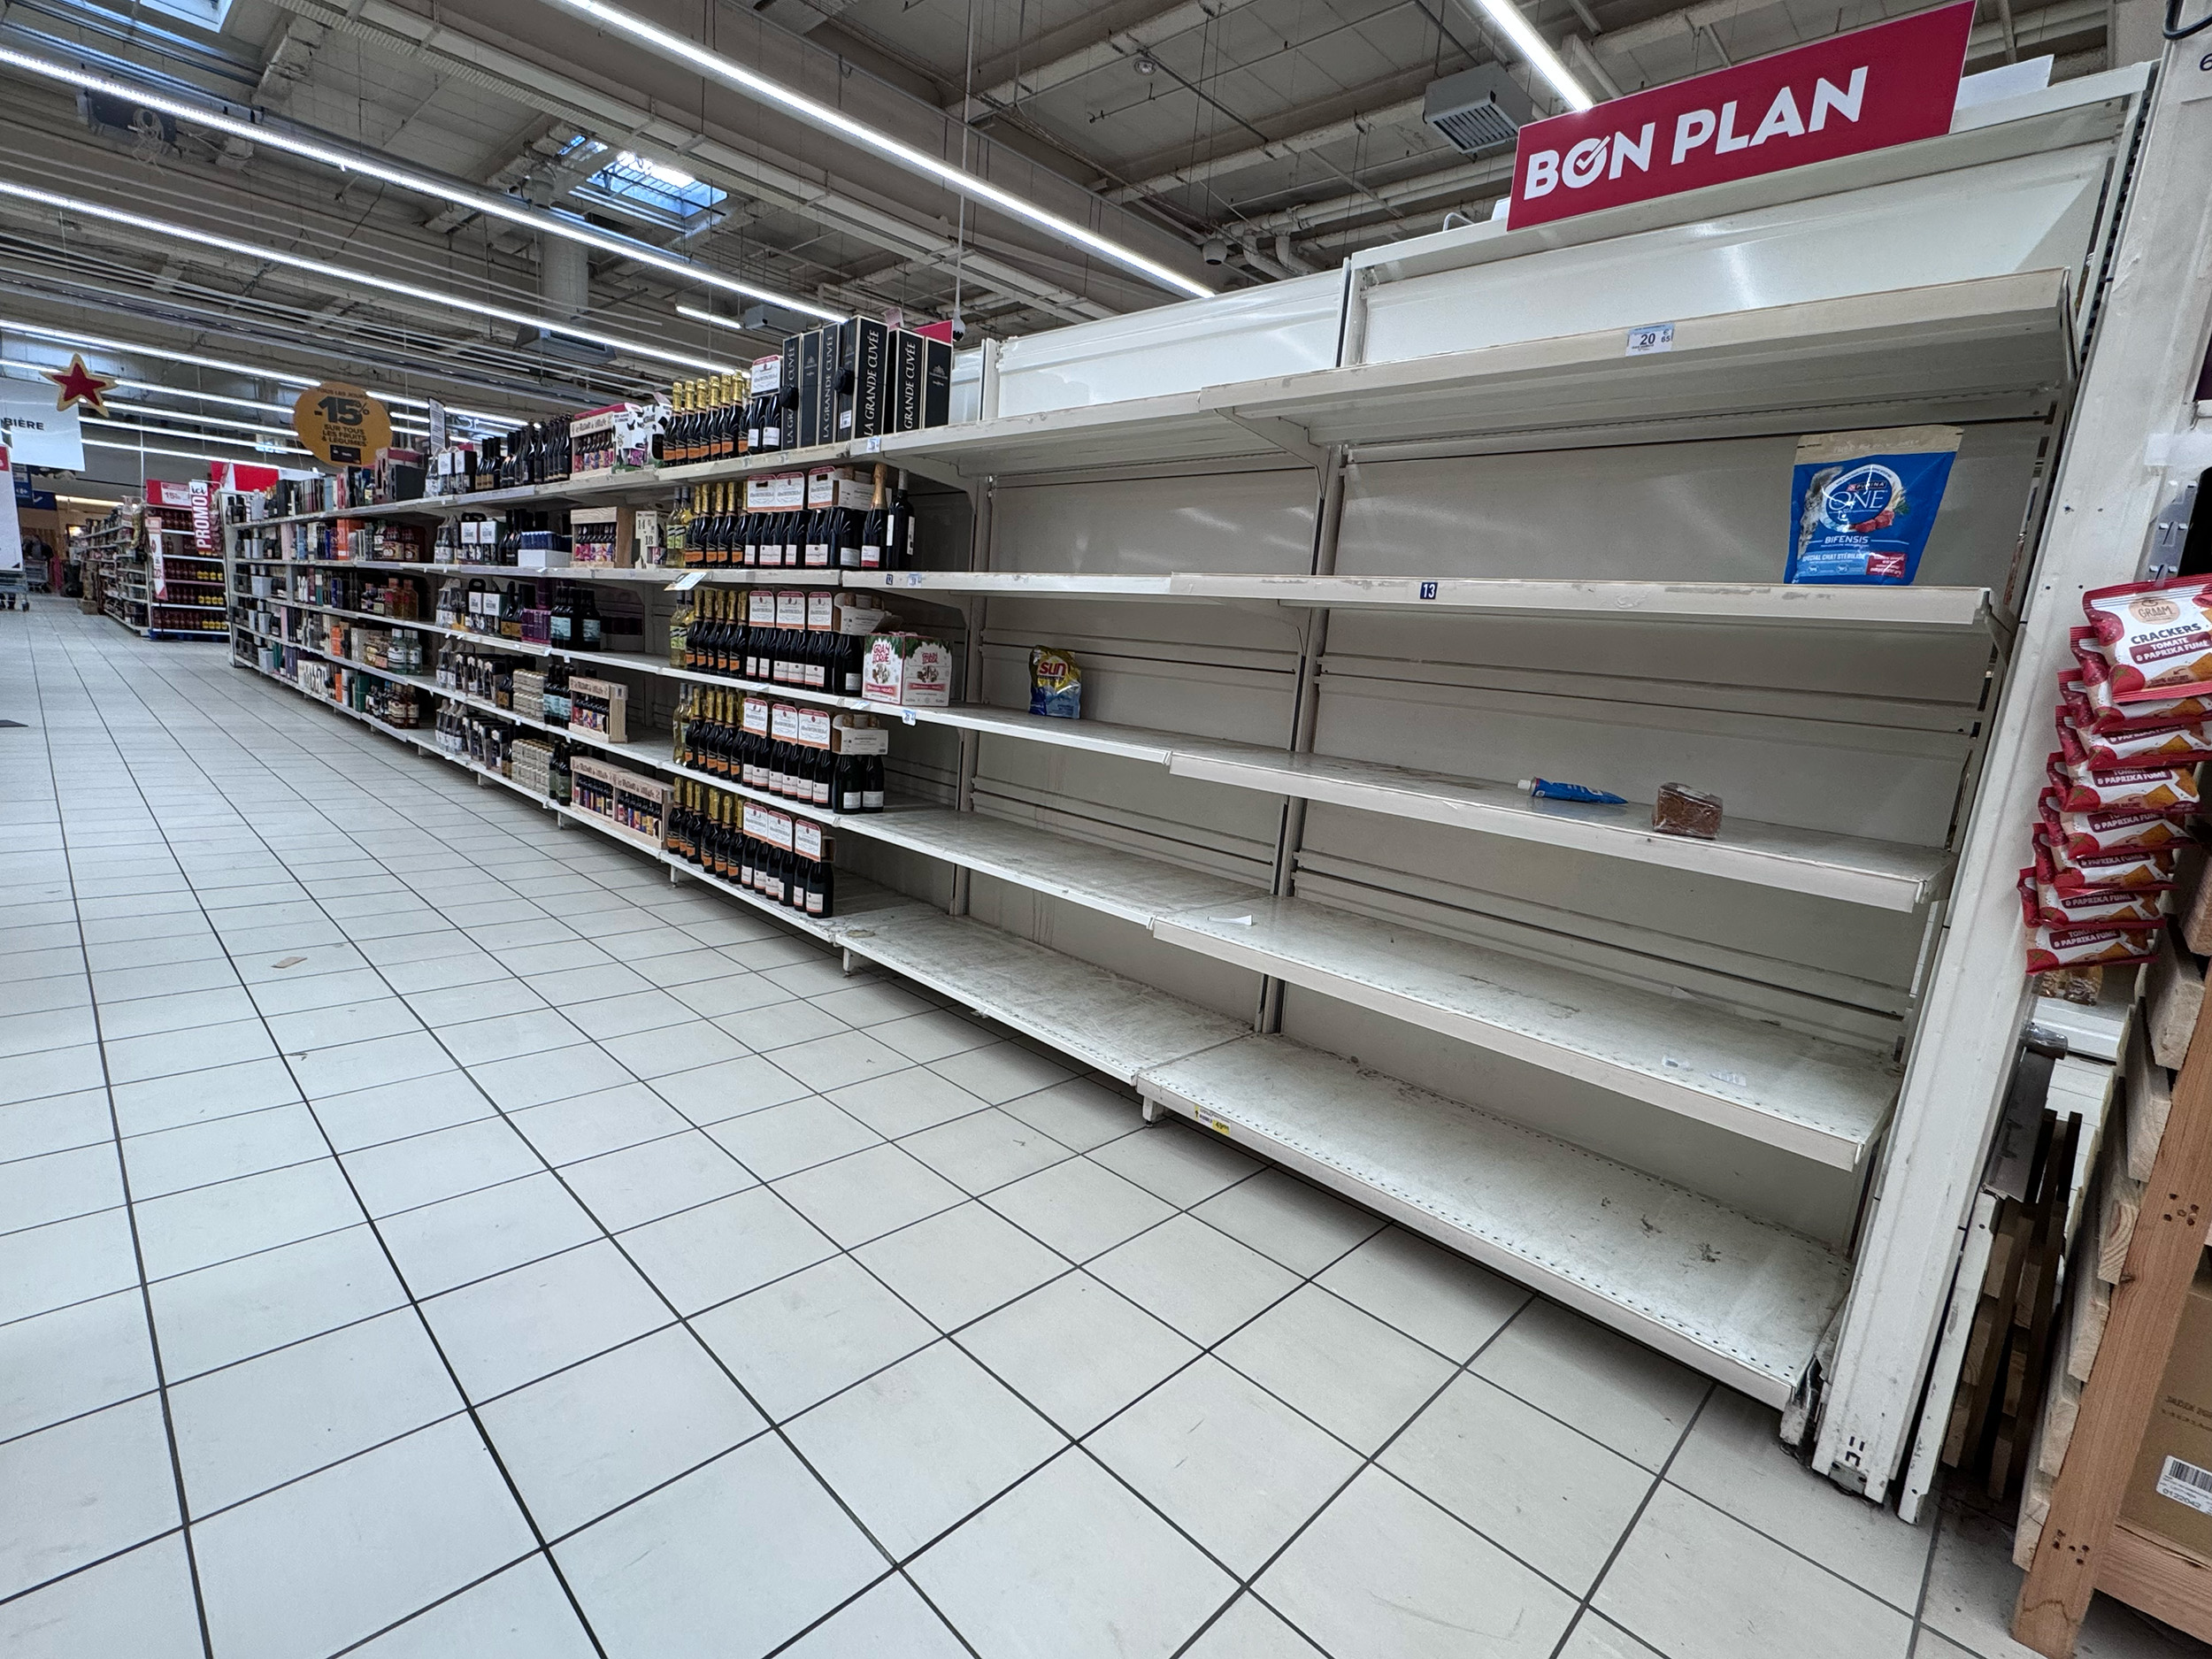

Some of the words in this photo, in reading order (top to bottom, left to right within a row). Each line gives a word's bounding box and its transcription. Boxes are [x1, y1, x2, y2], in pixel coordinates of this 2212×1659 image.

[1524, 122, 1655, 201] BON
[1671, 65, 1868, 165] PLAN
[1640, 333, 1655, 345] 20
[867, 329, 879, 368] CUVÉE
[905, 341, 917, 380] CUVÉE
[864, 370, 877, 420] GRANDE
[314, 396, 370, 426] -15%
[904, 380, 915, 429] GRANDE
[4, 417, 44, 430] BIÈRE
[343, 426, 365, 434] TOUS
[864, 423, 874, 436] LA
[339, 432, 366, 441] FRUITS
[787, 431, 794, 443] LA
[823, 425, 829, 438] LA
[191, 486, 207, 495] ici
[1829, 490, 1886, 511] ONE
[192, 495, 212, 549] PROMO
[1824, 535, 1870, 544] BIFENSIS
[1423, 584, 1435, 598] 13
[2131, 623, 2201, 645] CRACKERS
[2150, 637, 2189, 650] TOMATE
[2145, 646, 2185, 661] PAPRIKA
[2185, 640, 2210, 651] FUMÉ
[2105, 774, 2143, 784] PAPRIKA
[2101, 816, 2139, 828] PAPRIKA
[2072, 896, 2108, 905] PAPRIKA
[2061, 935, 2095, 947] PAPRIKA
